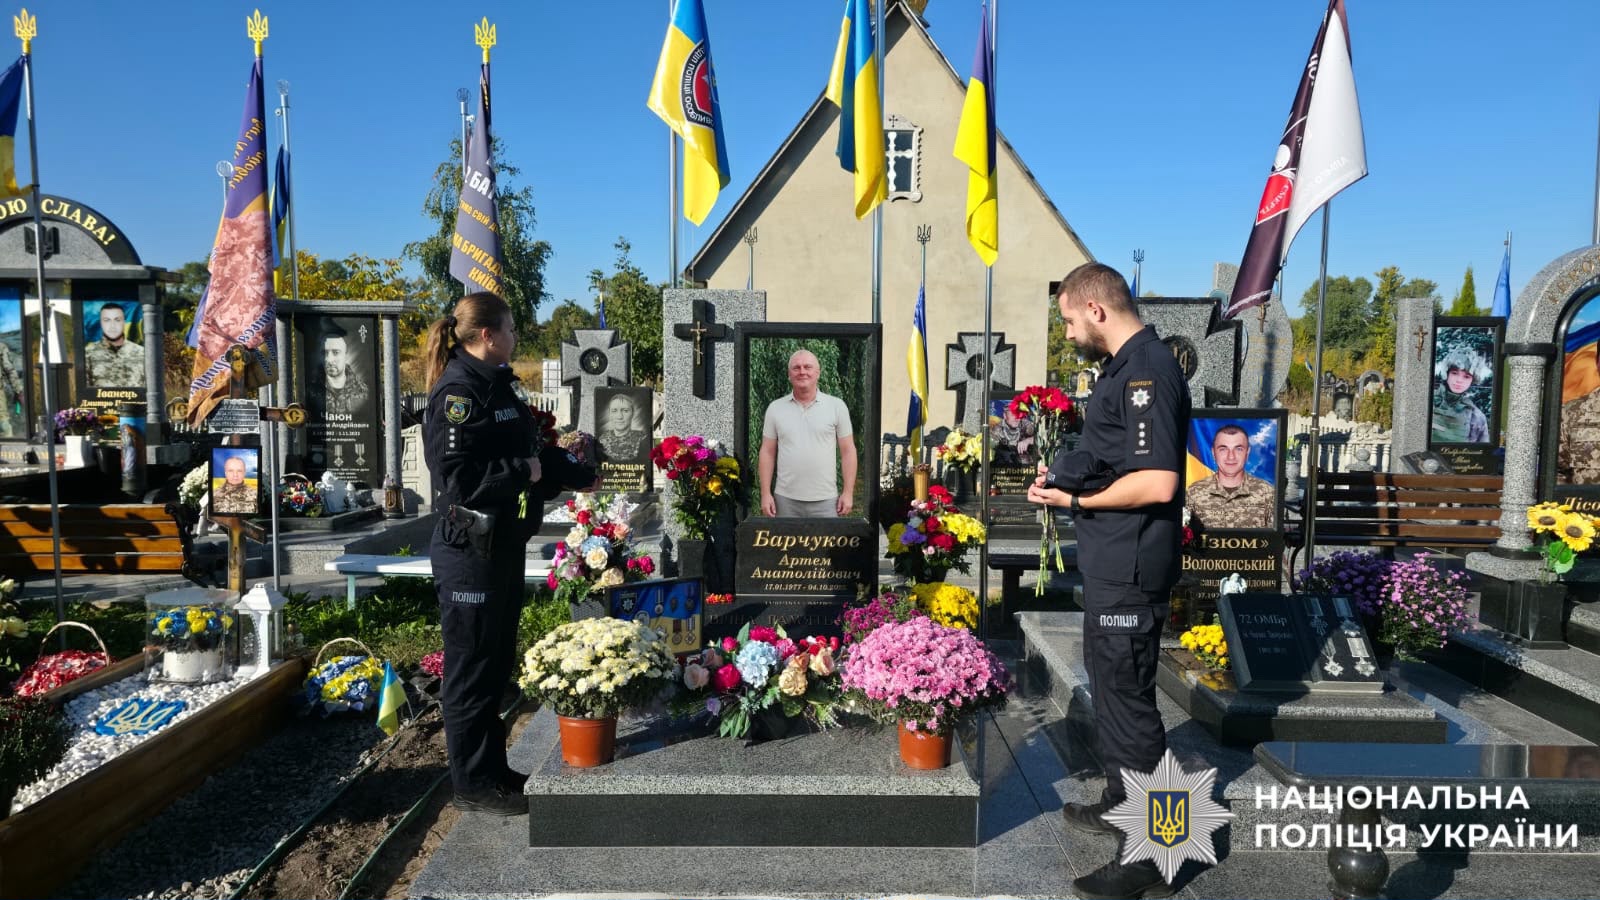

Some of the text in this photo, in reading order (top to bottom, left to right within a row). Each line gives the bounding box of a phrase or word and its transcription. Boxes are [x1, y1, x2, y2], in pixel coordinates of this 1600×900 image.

[685, 96, 714, 125] ОСОБЛИВ
[41, 198, 116, 246] СЛАВА!
[461, 238, 503, 278] БРИГАД
[468, 265, 504, 297] КИЇВС
[96, 388, 138, 400] Іванець
[601, 461, 646, 472] Пелещак
[753, 530, 861, 551] Барчуков
[779, 553, 832, 567] Артем
[751, 566, 861, 580] Анатолійович
[765, 583, 803, 591] 17.01.1977
[452, 591, 486, 603] ПОЛІЦІЯ
[1100, 614, 1139, 628] ПОЛІЦІЯ
